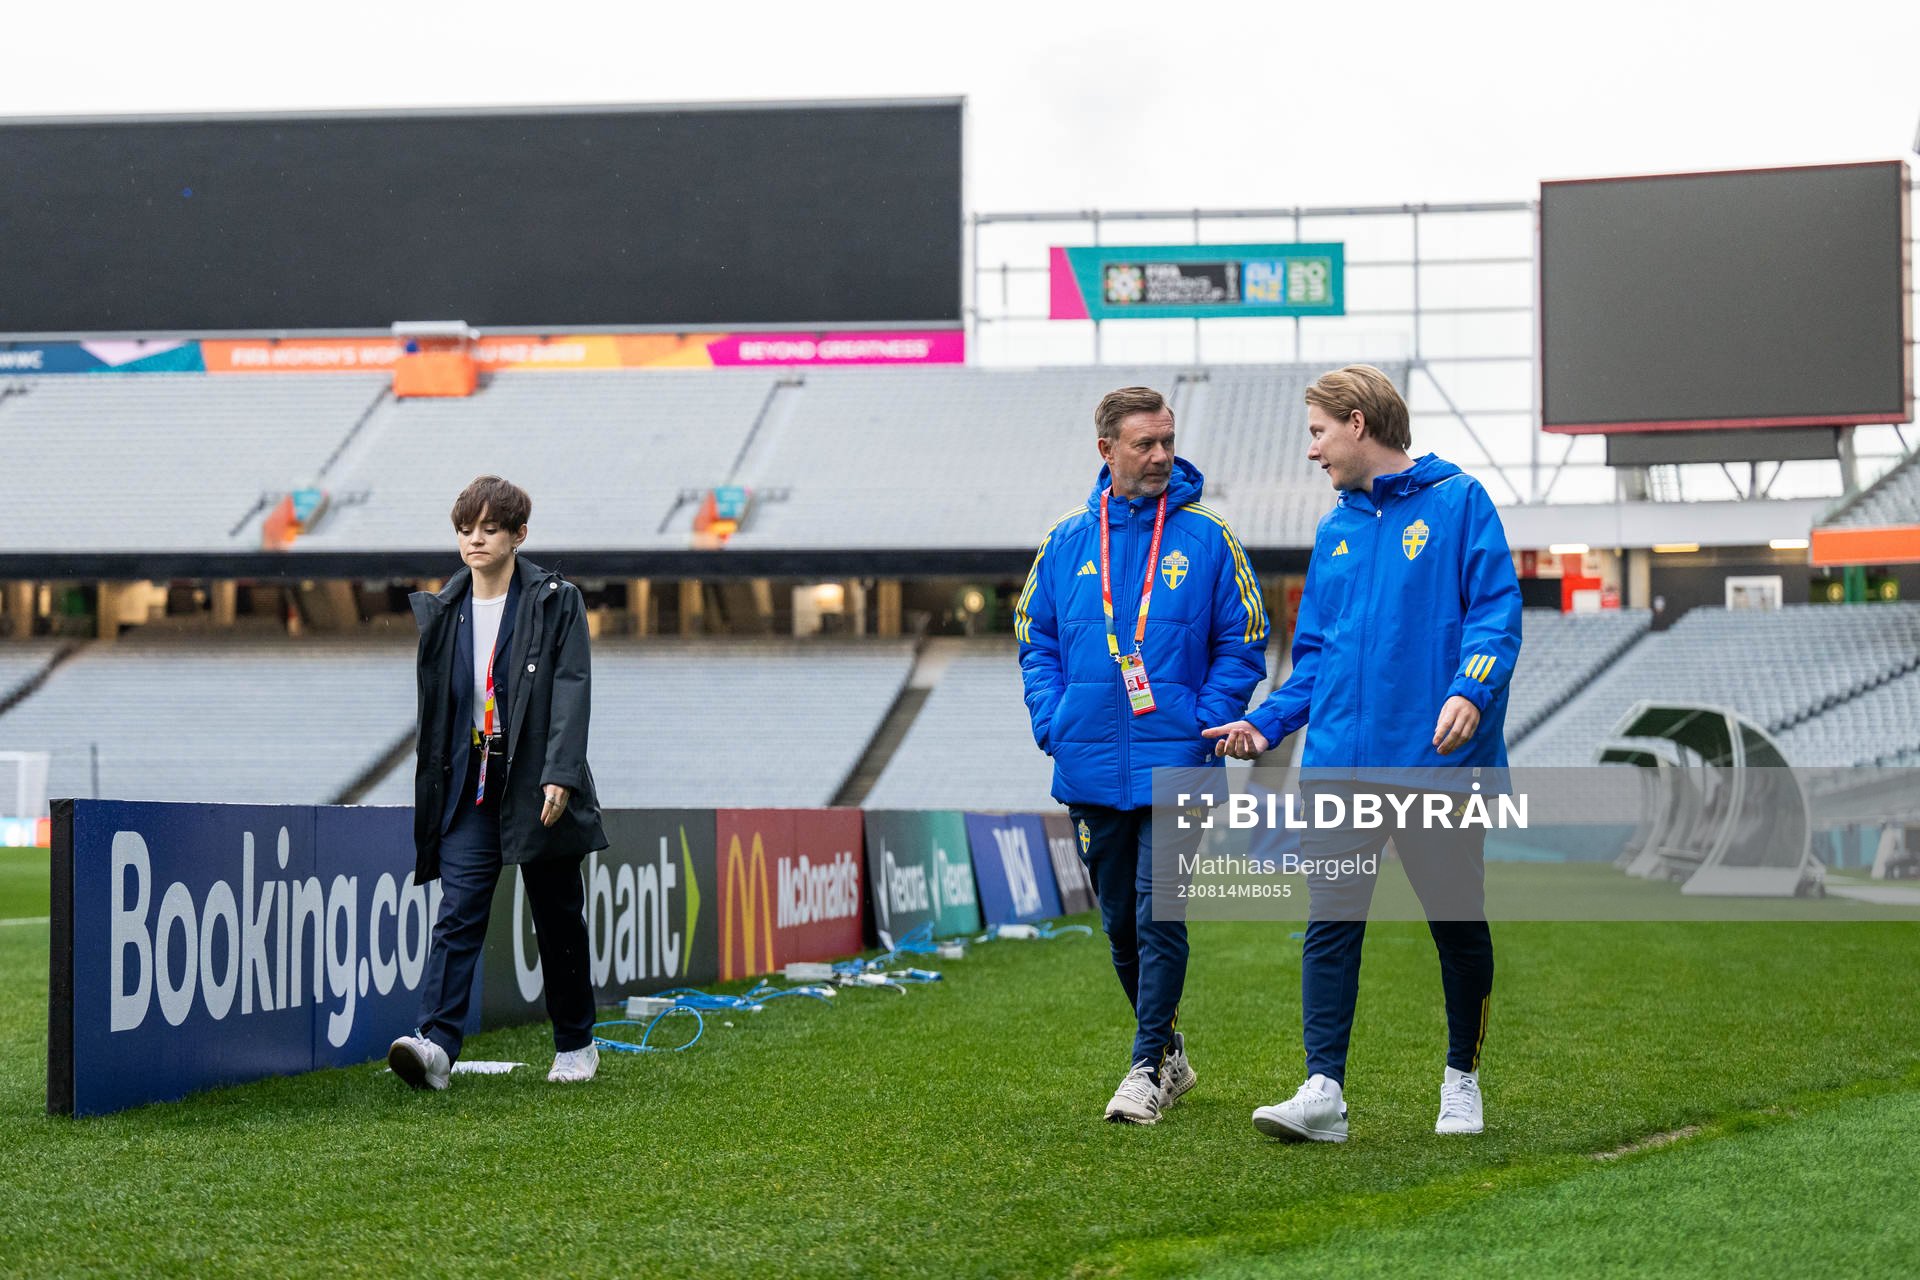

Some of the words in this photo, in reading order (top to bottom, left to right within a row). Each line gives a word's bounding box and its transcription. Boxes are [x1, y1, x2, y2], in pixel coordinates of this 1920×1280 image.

[359, 346, 402, 364] WOR
[739, 341, 816, 360] BEYOND
[817, 339, 931, 359] GREATNESS
[778, 852, 858, 929] McDonald's
[513, 837, 680, 1003] Gbant
